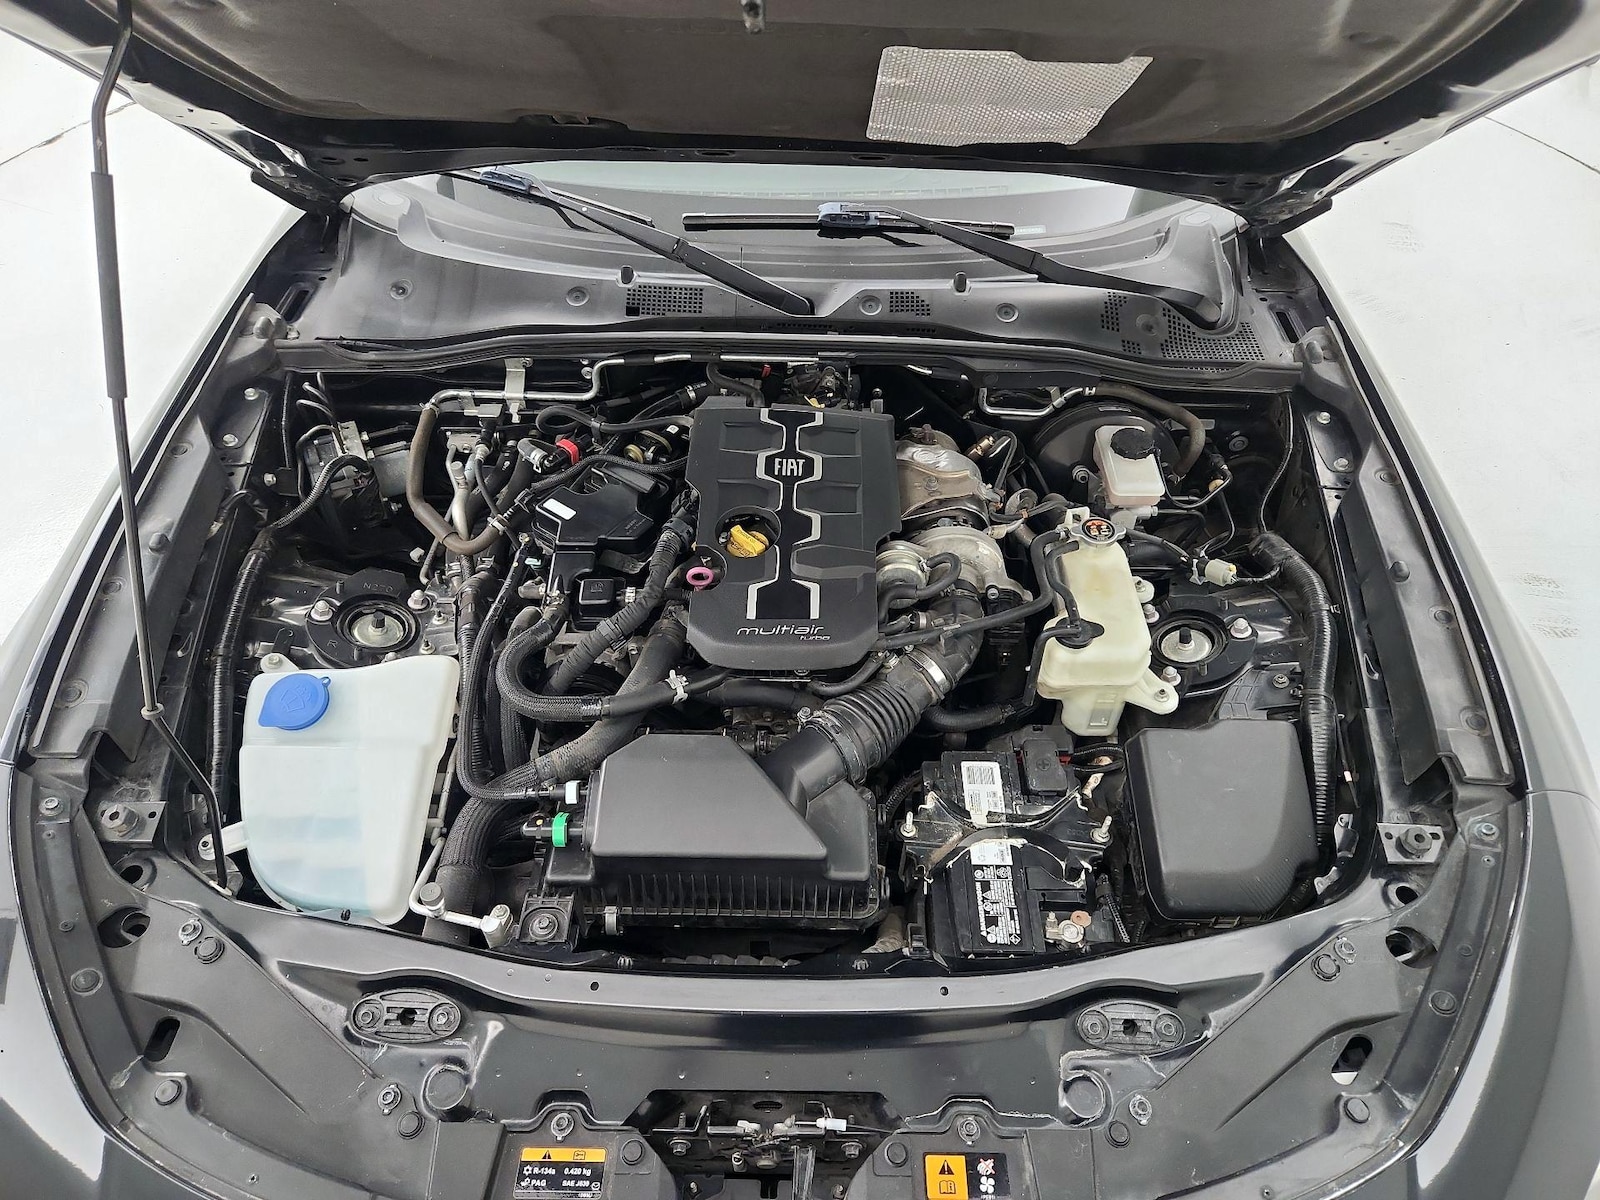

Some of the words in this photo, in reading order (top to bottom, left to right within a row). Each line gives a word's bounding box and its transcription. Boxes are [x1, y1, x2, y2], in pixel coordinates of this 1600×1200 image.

[774, 457, 805, 476] FIAT
[736, 624, 824, 635] multiair
[533, 1167, 556, 1175] R-134a
[564, 1167, 581, 1175] 0.420
[582, 1168, 592, 1177] kg
[531, 1179, 547, 1187] PAG
